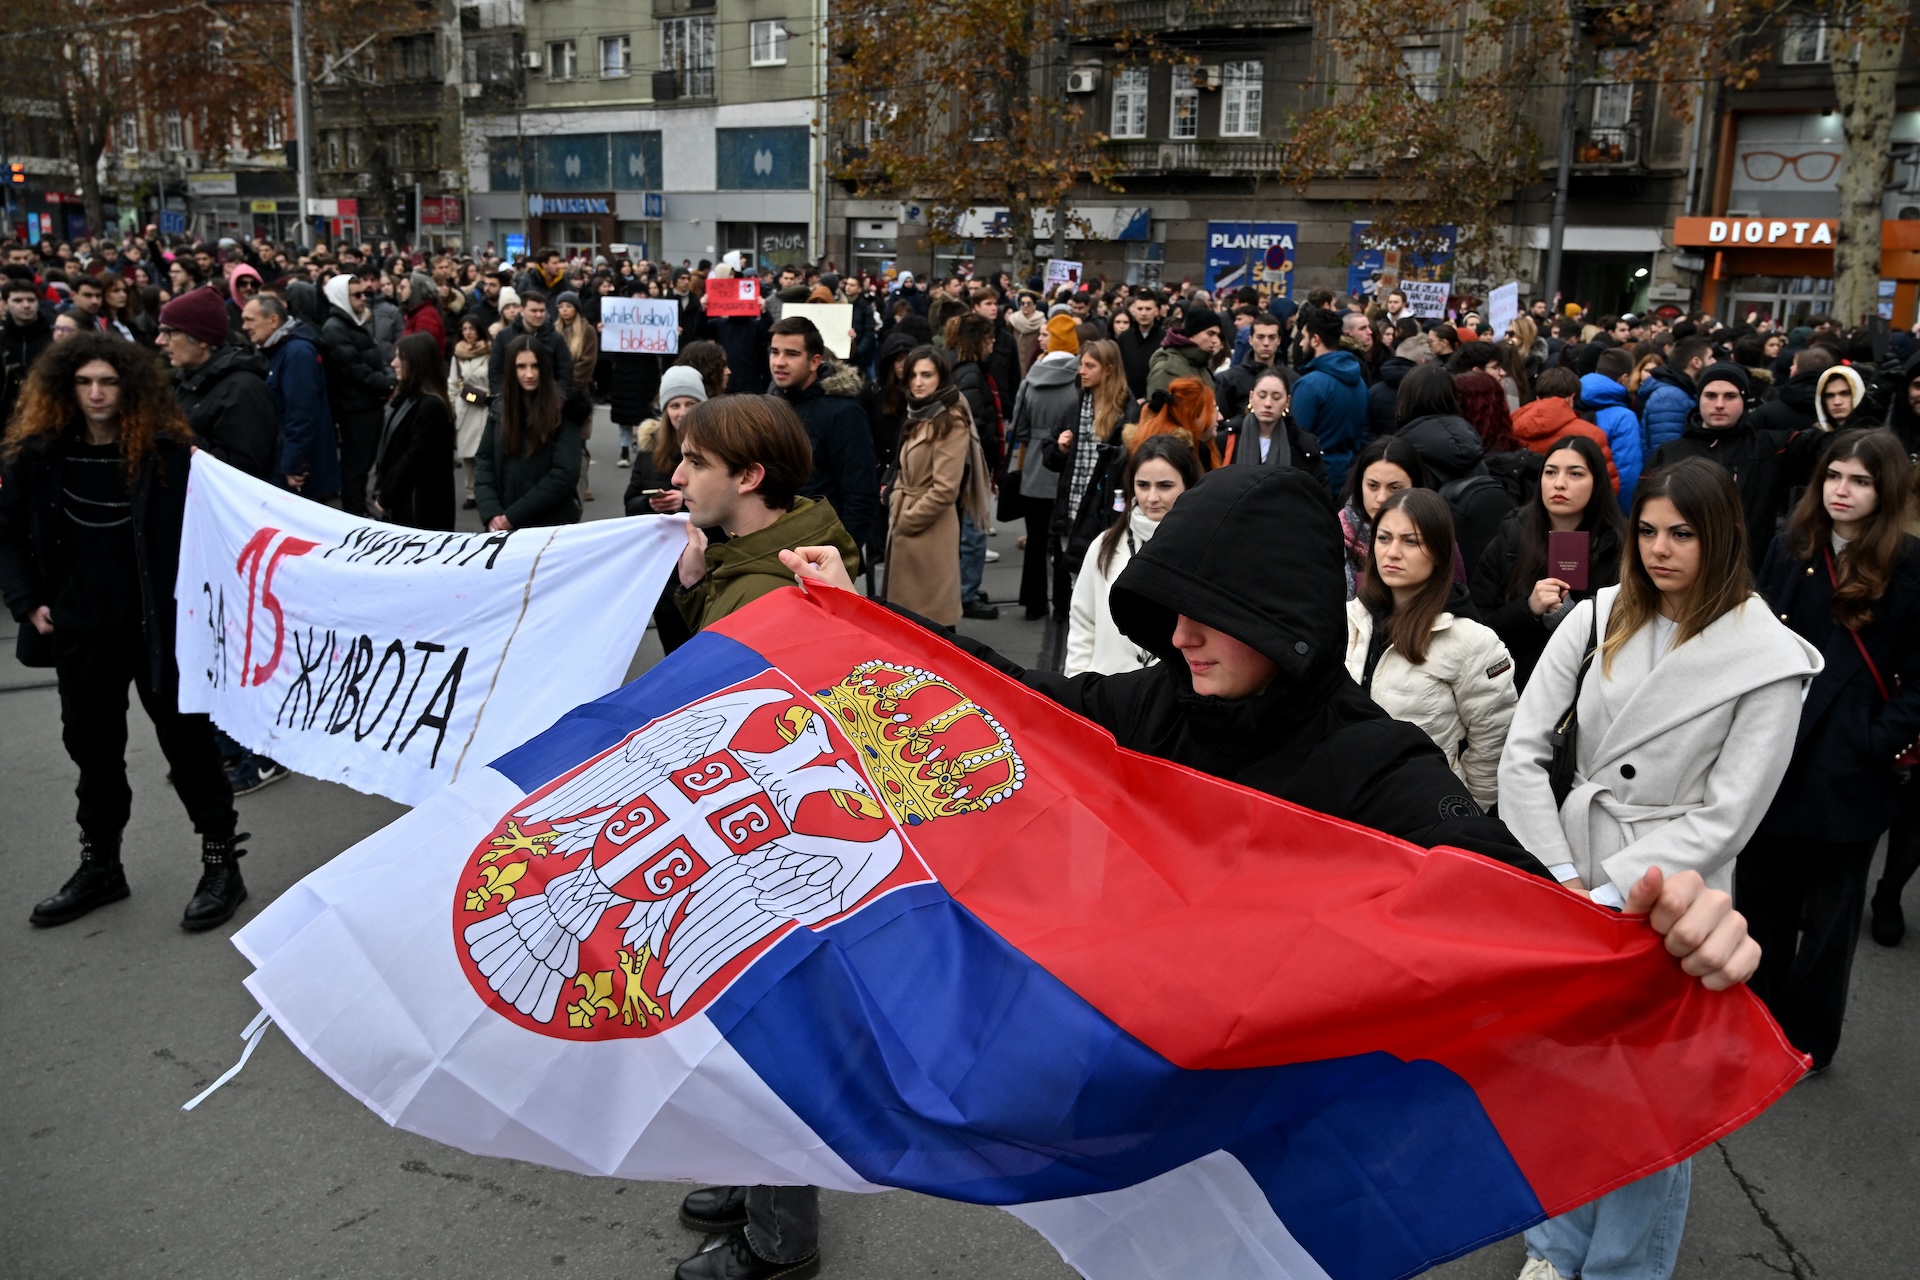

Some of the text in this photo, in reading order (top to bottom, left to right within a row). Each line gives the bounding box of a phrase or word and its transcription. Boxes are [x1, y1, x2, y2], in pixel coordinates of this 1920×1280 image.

[543, 198, 610, 214] HALKBANK
[1211, 234, 1294, 249] PLANETA
[1708, 221, 1832, 245] DIOPTA
[620, 328, 678, 353] blokada()
[236, 526, 518, 687] 15 МИНУТА
[203, 581, 470, 769] ЗА ЖИВОТА
